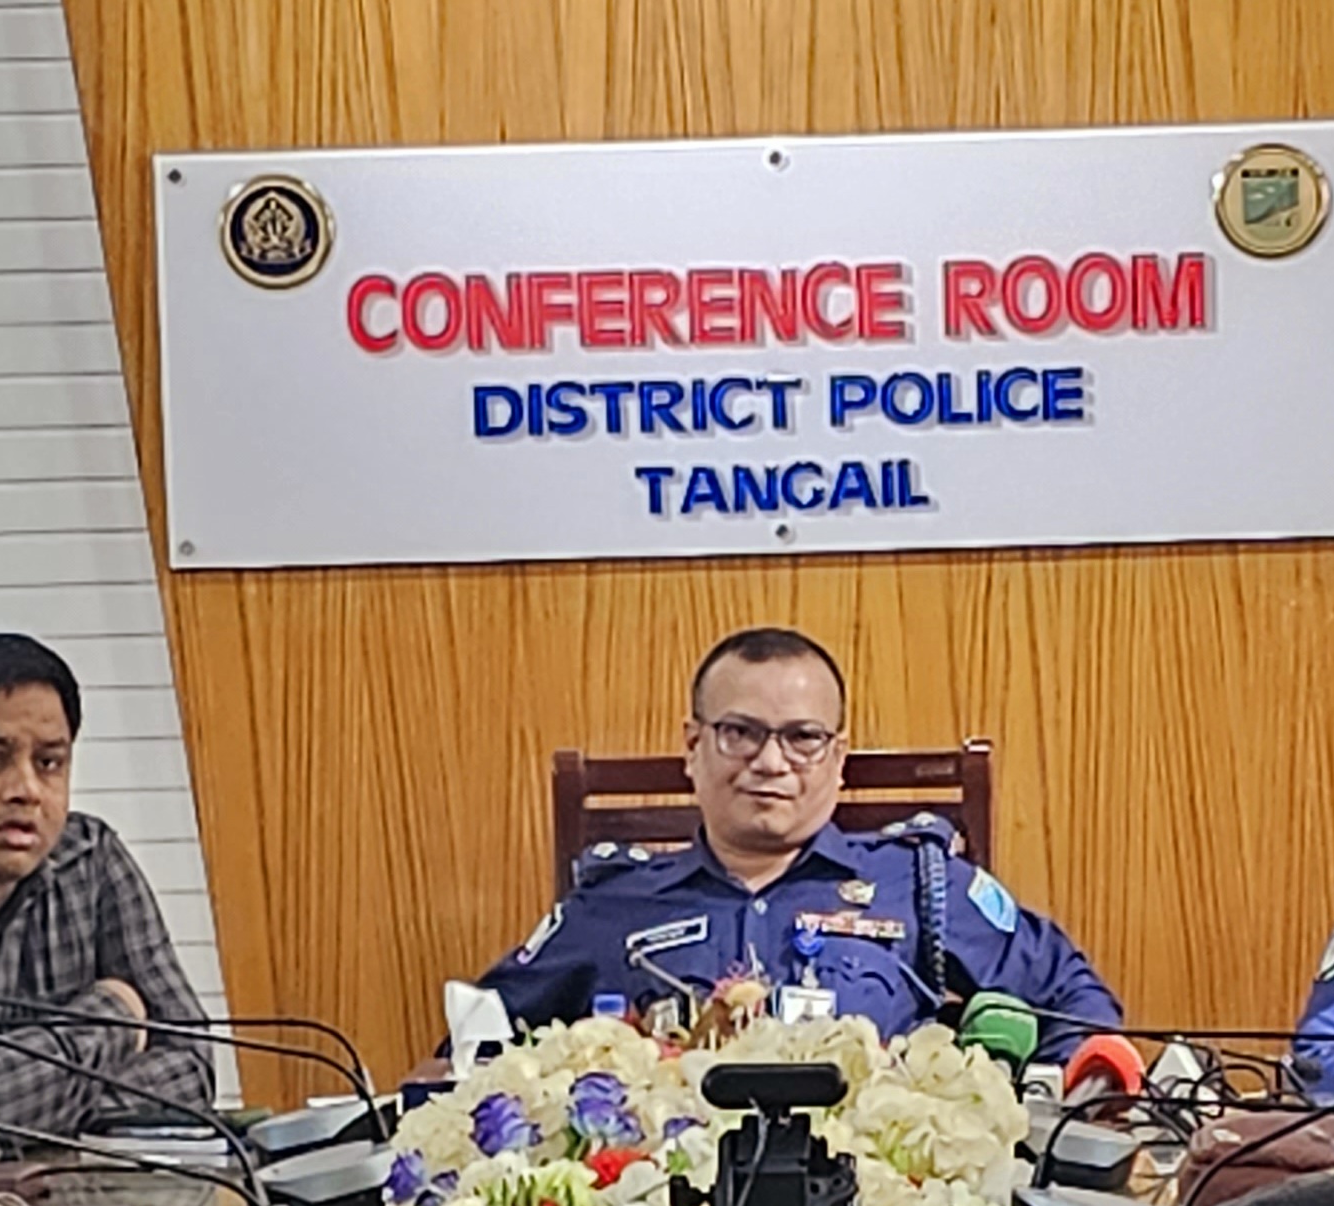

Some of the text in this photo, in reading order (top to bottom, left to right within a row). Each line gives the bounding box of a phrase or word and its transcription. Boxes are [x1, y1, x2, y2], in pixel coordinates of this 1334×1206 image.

[347, 253, 1208, 353] CONFERENCE ROOM
[473, 367, 1087, 439] DISTRICT POLICE
